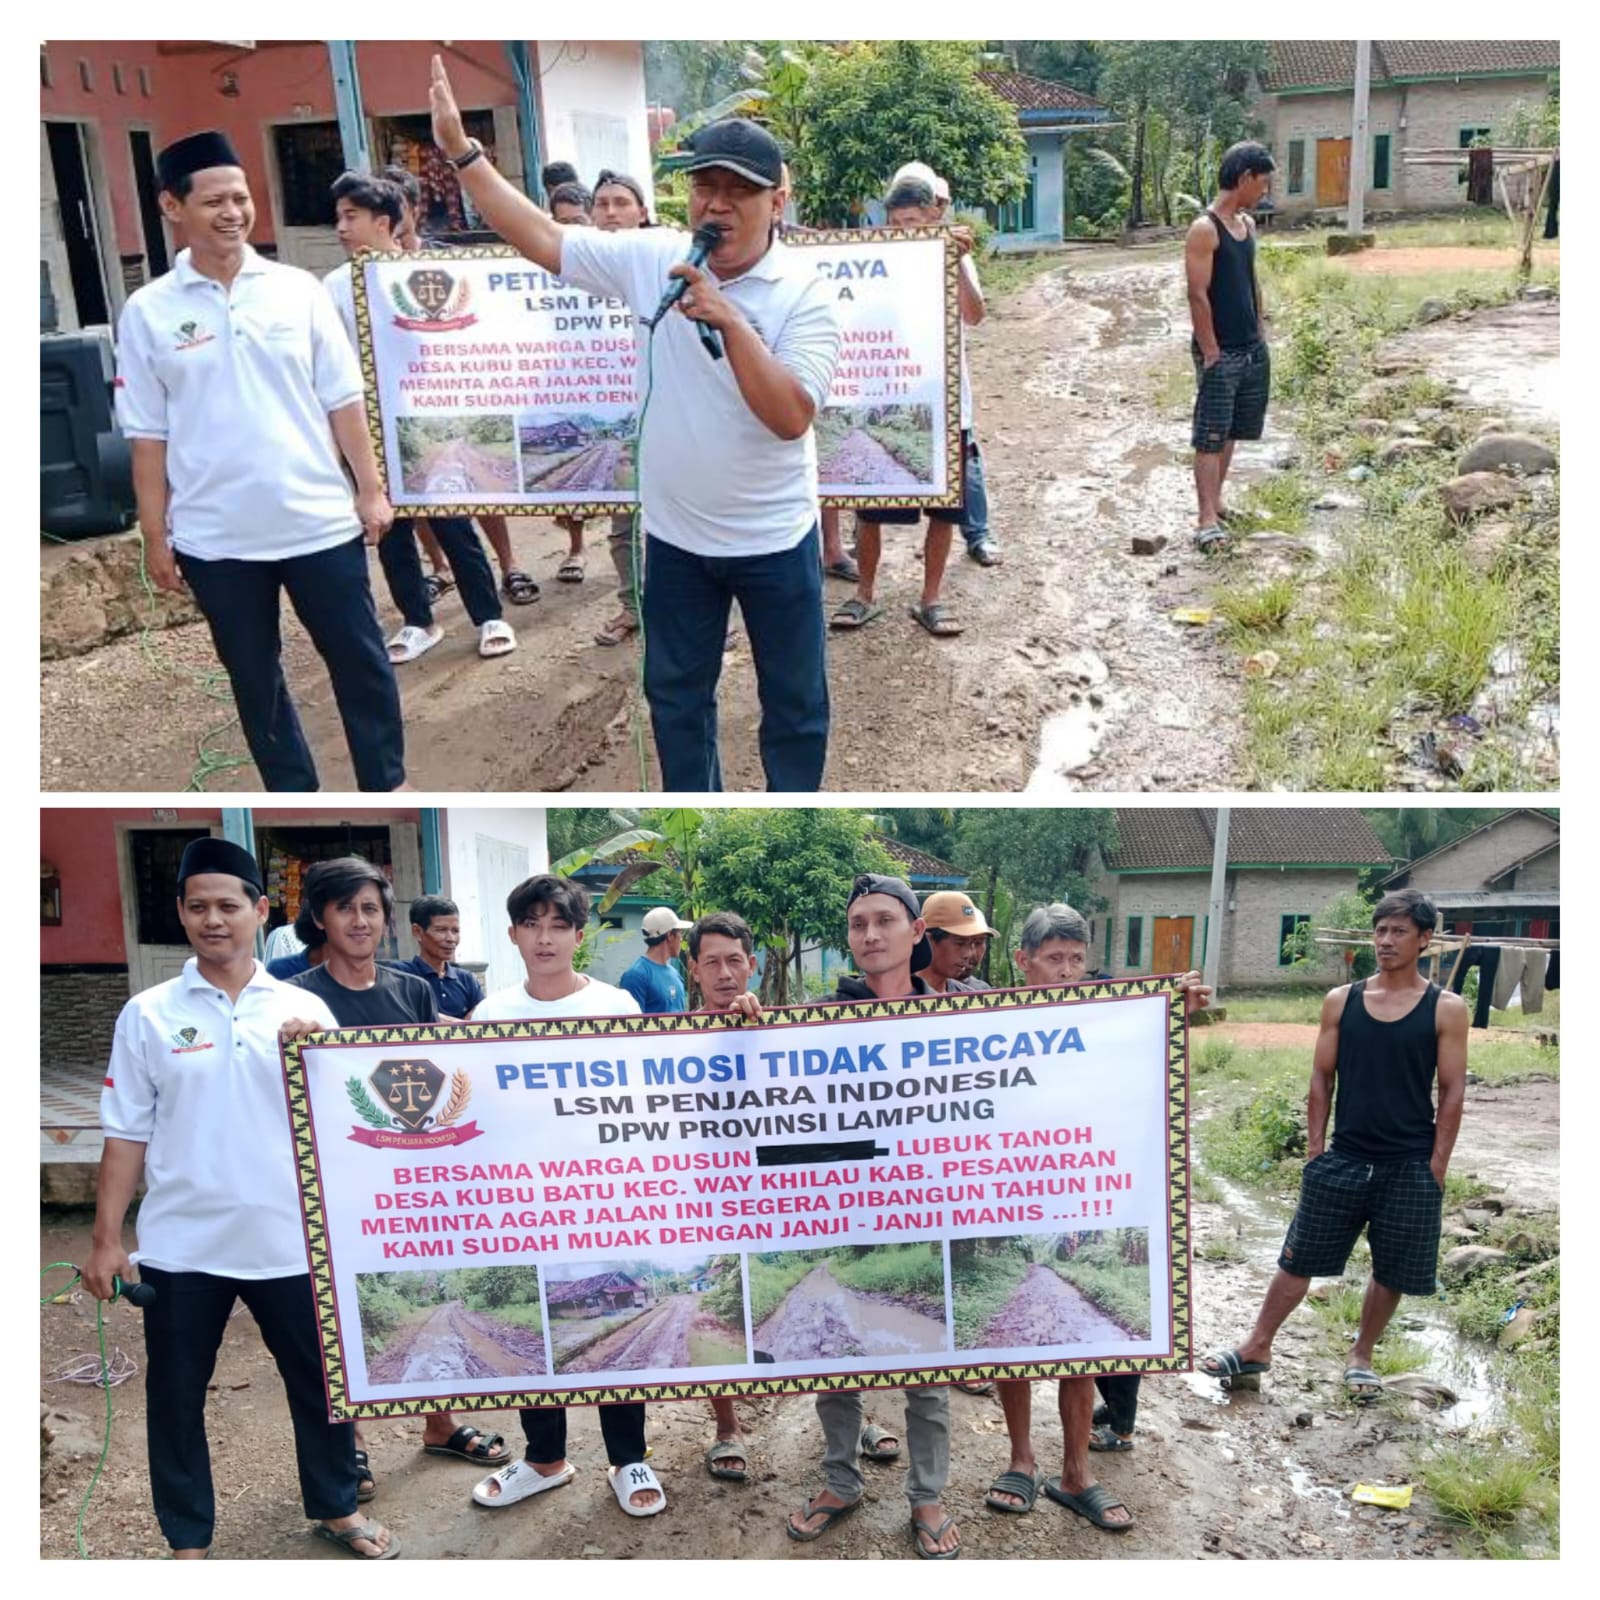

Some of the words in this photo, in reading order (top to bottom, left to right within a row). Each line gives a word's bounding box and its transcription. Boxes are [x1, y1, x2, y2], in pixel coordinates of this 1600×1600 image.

[488, 271, 577, 291] PETIS
[525, 296, 579, 311] LSM
[555, 315, 602, 331] DPW
[408, 361, 455, 374] DESA
[461, 360, 512, 373] KUBU
[518, 357, 566, 371] BATU
[571, 356, 614, 369] KEC.
[839, 347, 909, 360] WARAN
[419, 343, 512, 357] BERSAMA
[516, 340, 585, 353] WARGA
[591, 339, 636, 352] DUS
[399, 377, 484, 391] MEMINTA
[489, 375, 540, 389] AGAR
[546, 374, 601, 387] JALAN
[607, 373, 632, 385] INI
[833, 365, 889, 379] AHUN
[895, 364, 922, 377] INI
[413, 395, 459, 407] KAMI
[465, 393, 529, 407] SUDAH
[534, 391, 590, 405] MUAK
[596, 390, 639, 403] DEN
[830, 384, 860, 396] NIS
[496, 1060, 627, 1090] PETISI
[643, 1054, 746, 1085] MOSI
[760, 1044, 887, 1077] TIDAK
[902, 1027, 1085, 1069] PERCAYA
[554, 1096, 633, 1116] LSM
[647, 1086, 816, 1113] PENJARA
[828, 1067, 1037, 1103] INDONESIA
[599, 1122, 669, 1143] DPW
[680, 1113, 826, 1139] PROVINSI
[838, 1099, 995, 1131] LAMPUNG
[394, 1163, 532, 1184] BERSAMA
[539, 1157, 644, 1178] WARGA
[653, 1151, 751, 1172] DUSUN
[898, 1135, 991, 1156] LUBUK
[999, 1127, 1092, 1149] TANOH
[375, 1191, 448, 1210] DESA
[456, 1188, 534, 1206] KUBU
[544, 1183, 614, 1202] BATU
[624, 1180, 686, 1199] KEC.
[694, 1175, 752, 1194] WAY
[762, 1168, 859, 1190] KHILAU
[870, 1164, 932, 1183] KAB.
[943, 1150, 1115, 1178] PESAWARAN
[362, 1214, 493, 1235] MEMINTA
[500, 1210, 576, 1229] AGAR
[584, 1205, 667, 1225] JALAN
[676, 1202, 713, 1219] INI
[722, 1195, 830, 1217] SEGERA
[839, 1184, 985, 1209] DIBANGUN
[992, 1177, 1086, 1198] TAHUN
[1096, 1174, 1132, 1192] INI
[384, 1240, 454, 1258] KAMI
[463, 1235, 558, 1254] SUDAH
[568, 1230, 651, 1249] MUAK
[660, 1223, 772, 1245] DENGAN
[781, 1217, 849, 1237] JANJI
[874, 1212, 943, 1231] JANJI
[953, 1205, 1043, 1225] MANIS
[1054, 1200, 1112, 1219] ...!!!
